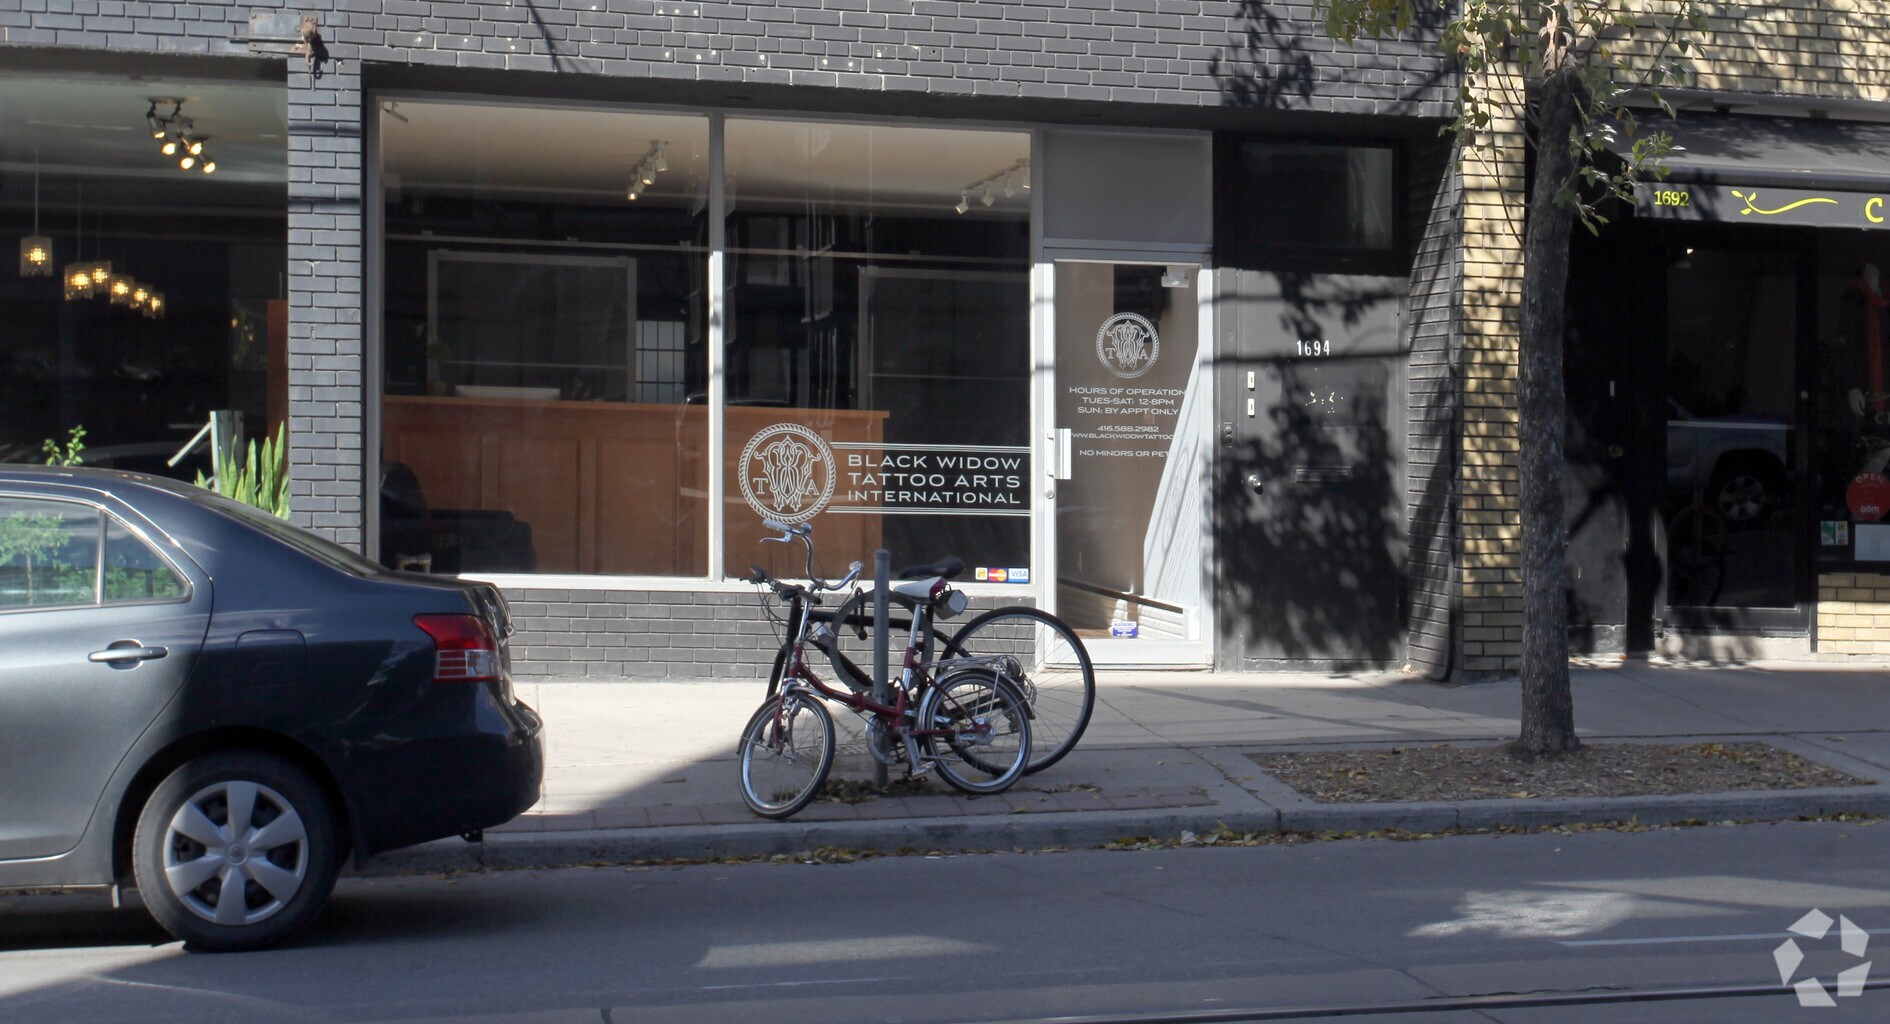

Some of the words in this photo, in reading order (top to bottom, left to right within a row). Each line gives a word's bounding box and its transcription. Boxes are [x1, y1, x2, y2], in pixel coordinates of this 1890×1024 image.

[1654, 190, 1689, 207] 1692
[1296, 339, 1330, 356] 1694
[1069, 386, 1108, 395] HOURS
[1109, 387, 1124, 395] OF
[1126, 387, 1188, 396] OPERATION
[1077, 406, 1103, 414] SUN:
[1120, 407, 1150, 415] APPT
[1151, 407, 1179, 416] ONLY
[1079, 449, 1095, 457] NO
[1096, 450, 1134, 458] MINORS
[1135, 450, 1150, 458] OR
[1151, 450, 1174, 459] PET
[848, 454, 928, 469] BLACK
[936, 456, 1021, 470] WIDOW
[848, 472, 946, 487] TATTOO
[953, 474, 1021, 488] ARTS
[1855, 472, 1884, 483] OPEN
[848, 490, 1021, 504] INTERNATIONAL
[1010, 570, 1027, 578] VISA
